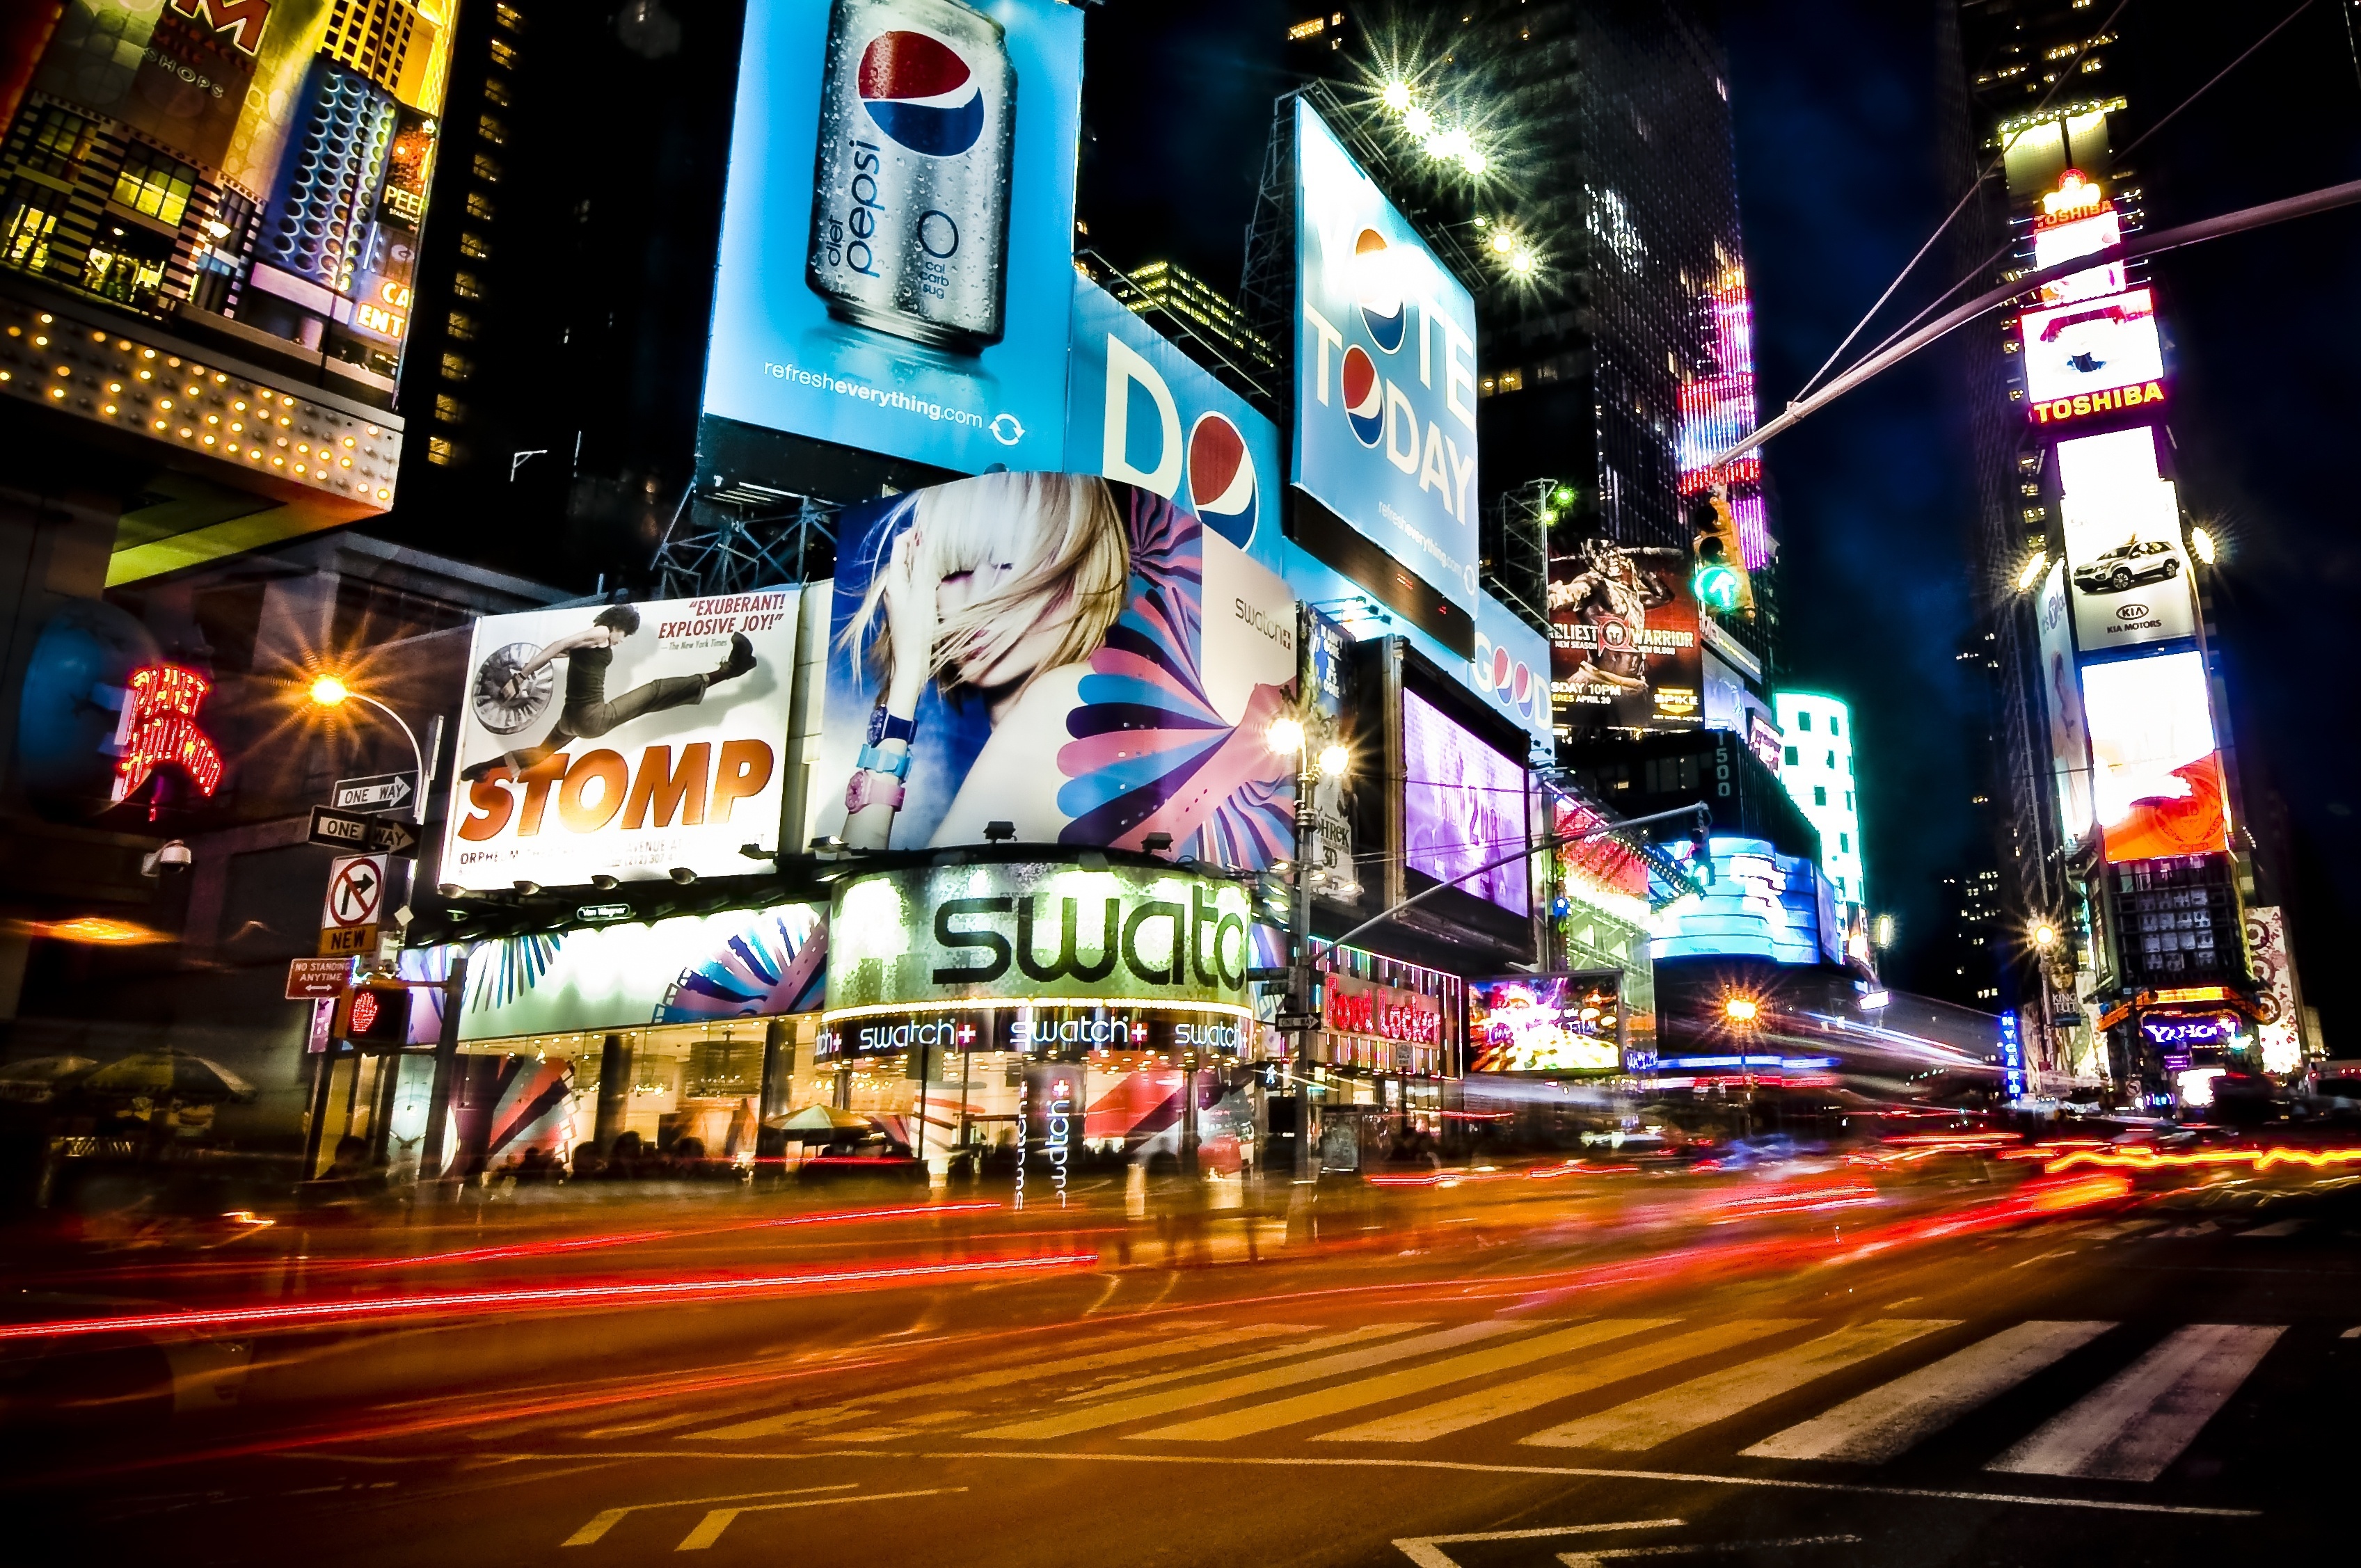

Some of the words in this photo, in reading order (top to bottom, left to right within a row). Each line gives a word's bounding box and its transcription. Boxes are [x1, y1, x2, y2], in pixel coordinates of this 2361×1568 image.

[143, 47, 223, 98] SHOPS
[122, 124, 209, 172] SEPHORA
[218, 172, 264, 206] SEPHORA
[846, 140, 886, 278] pepsi
[2034, 200, 2113, 228] TOSHIBA
[826, 214, 843, 266] diet
[925, 261, 946, 273] cal
[919, 271, 950, 287] carb
[923, 284, 944, 299] sug
[357, 303, 405, 337] ENT
[764, 360, 984, 429] refresheverything.com
[2034, 381, 2165, 424] TOSHIBA
[1235, 598, 1282, 645] swatch
[2122, 607, 2143, 617] KIA
[658, 617, 737, 639] EXPLOSIVE
[1631, 627, 1694, 648] WARRIOR
[2107, 625, 2122, 634] KIA
[2124, 620, 2162, 631] MOTORS
[669, 641, 678, 650] The
[681, 640, 694, 649] New
[696, 638, 708, 648] York
[710, 638, 727, 648] Times
[1555, 640, 1570, 648] NEW
[1571, 641, 1598, 650] SEASON
[1576, 695, 1600, 704] APRIL
[1601, 696, 1612, 705] 20
[1589, 683, 1621, 696] 10PM
[1654, 694, 1699, 705] SPIKE
[1716, 731, 1731, 797] 1500
[344, 788, 369, 805] ONE
[379, 782, 406, 801] WAY
[456, 738, 774, 841] STOMP
[327, 819, 360, 839] ONE
[374, 827, 406, 847] WAY
[460, 849, 519, 865] ORPHEM
[1322, 846, 1338, 869] 3D
[330, 929, 366, 951] NEW
[932, 886, 1250, 993] swatc
[295, 962, 308, 972] NO
[310, 961, 351, 973] STANDING
[299, 973, 342, 982] ANYTIME
[2052, 993, 2077, 1003] KING
[2053, 1002, 2076, 1013] TUT
[1010, 1014, 1128, 1043] swatch
[1281, 1018, 1294, 1027] ONE
[1300, 1017, 1314, 1027] WAY
[859, 1018, 955, 1050] swatch
[1174, 1022, 1243, 1048] swatch
